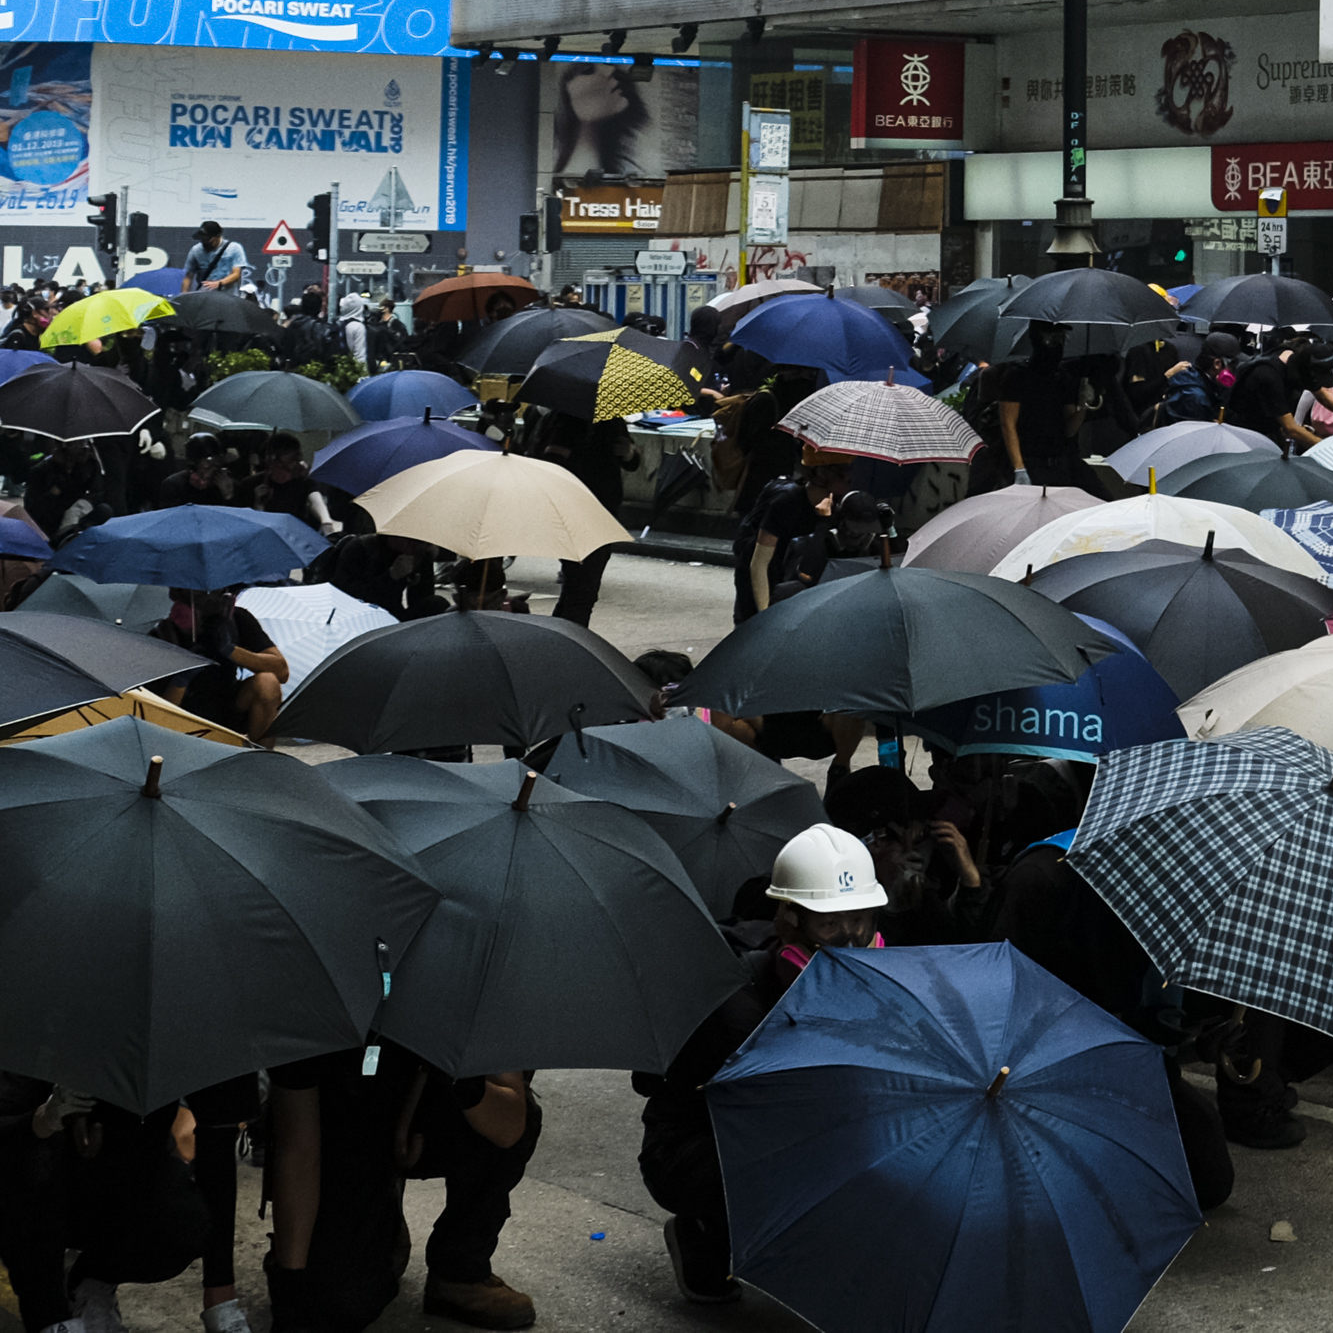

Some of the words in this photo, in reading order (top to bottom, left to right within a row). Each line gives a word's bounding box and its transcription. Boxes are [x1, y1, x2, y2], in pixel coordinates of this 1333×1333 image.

[288, 1, 355, 19] SWEAT
[170, 102, 280, 127] POCARI
[288, 108, 392, 131] SWEAT
[875, 114, 905, 127] BEA
[907, 115, 953, 130] 東亞銀行
[169, 124, 232, 150] RUN
[244, 126, 389, 154] CARNIVAL
[389, 112, 403, 154] 2019
[564, 196, 620, 218] Tress
[1261, 222, 1271, 233] 24
[1272, 222, 1284, 233] hrs
[973, 698, 1103, 742] shama
